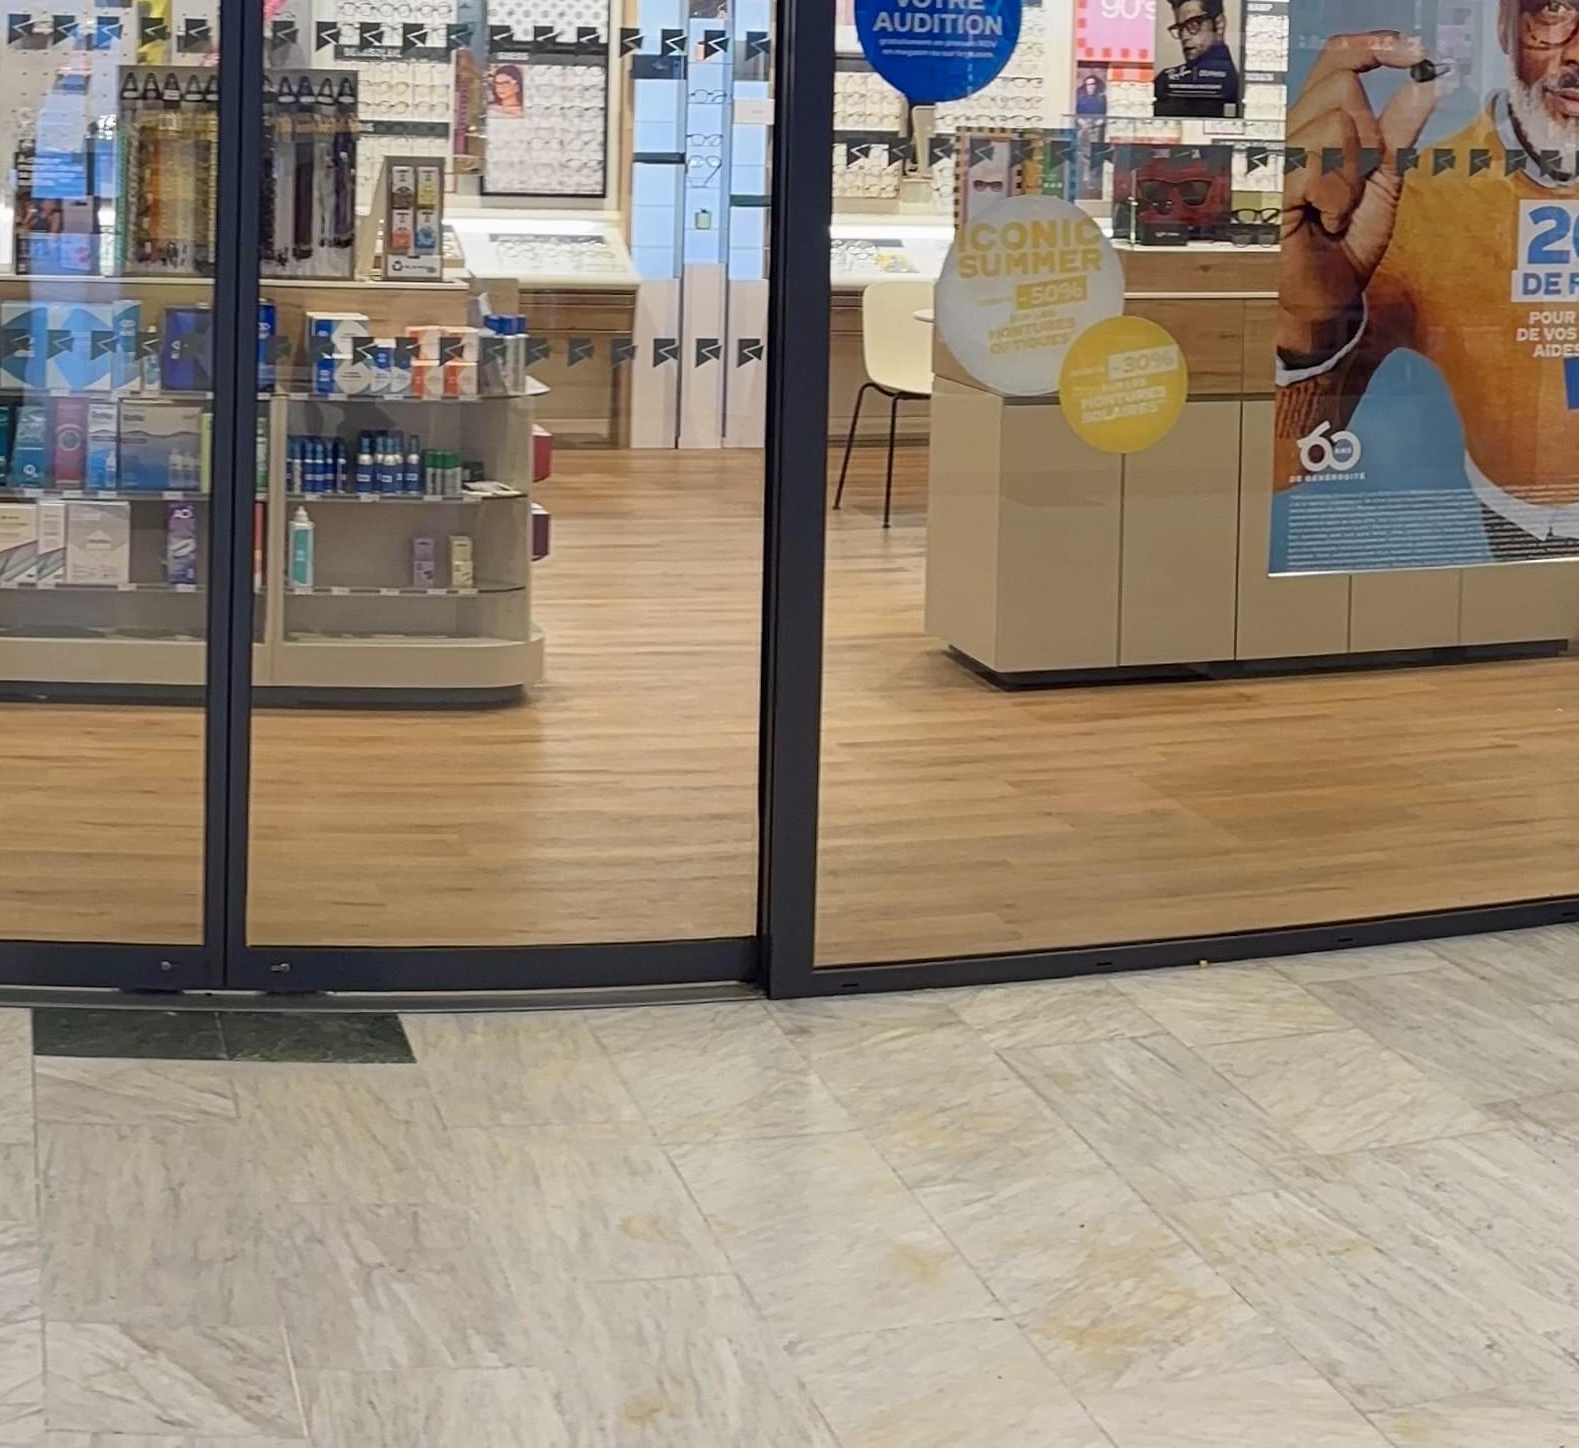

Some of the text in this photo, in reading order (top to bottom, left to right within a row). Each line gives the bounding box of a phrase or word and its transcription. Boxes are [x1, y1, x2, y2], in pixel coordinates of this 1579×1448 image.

[872, 11, 1004, 36] AUDITION
[955, 216, 1103, 253] ICONIC
[957, 248, 1103, 280] SUMMER
[1521, 272, 1562, 296] DE
[1528, 310, 1576, 325] POUR
[1516, 327, 1541, 342] DE
[1543, 326, 1578, 341] VOS
